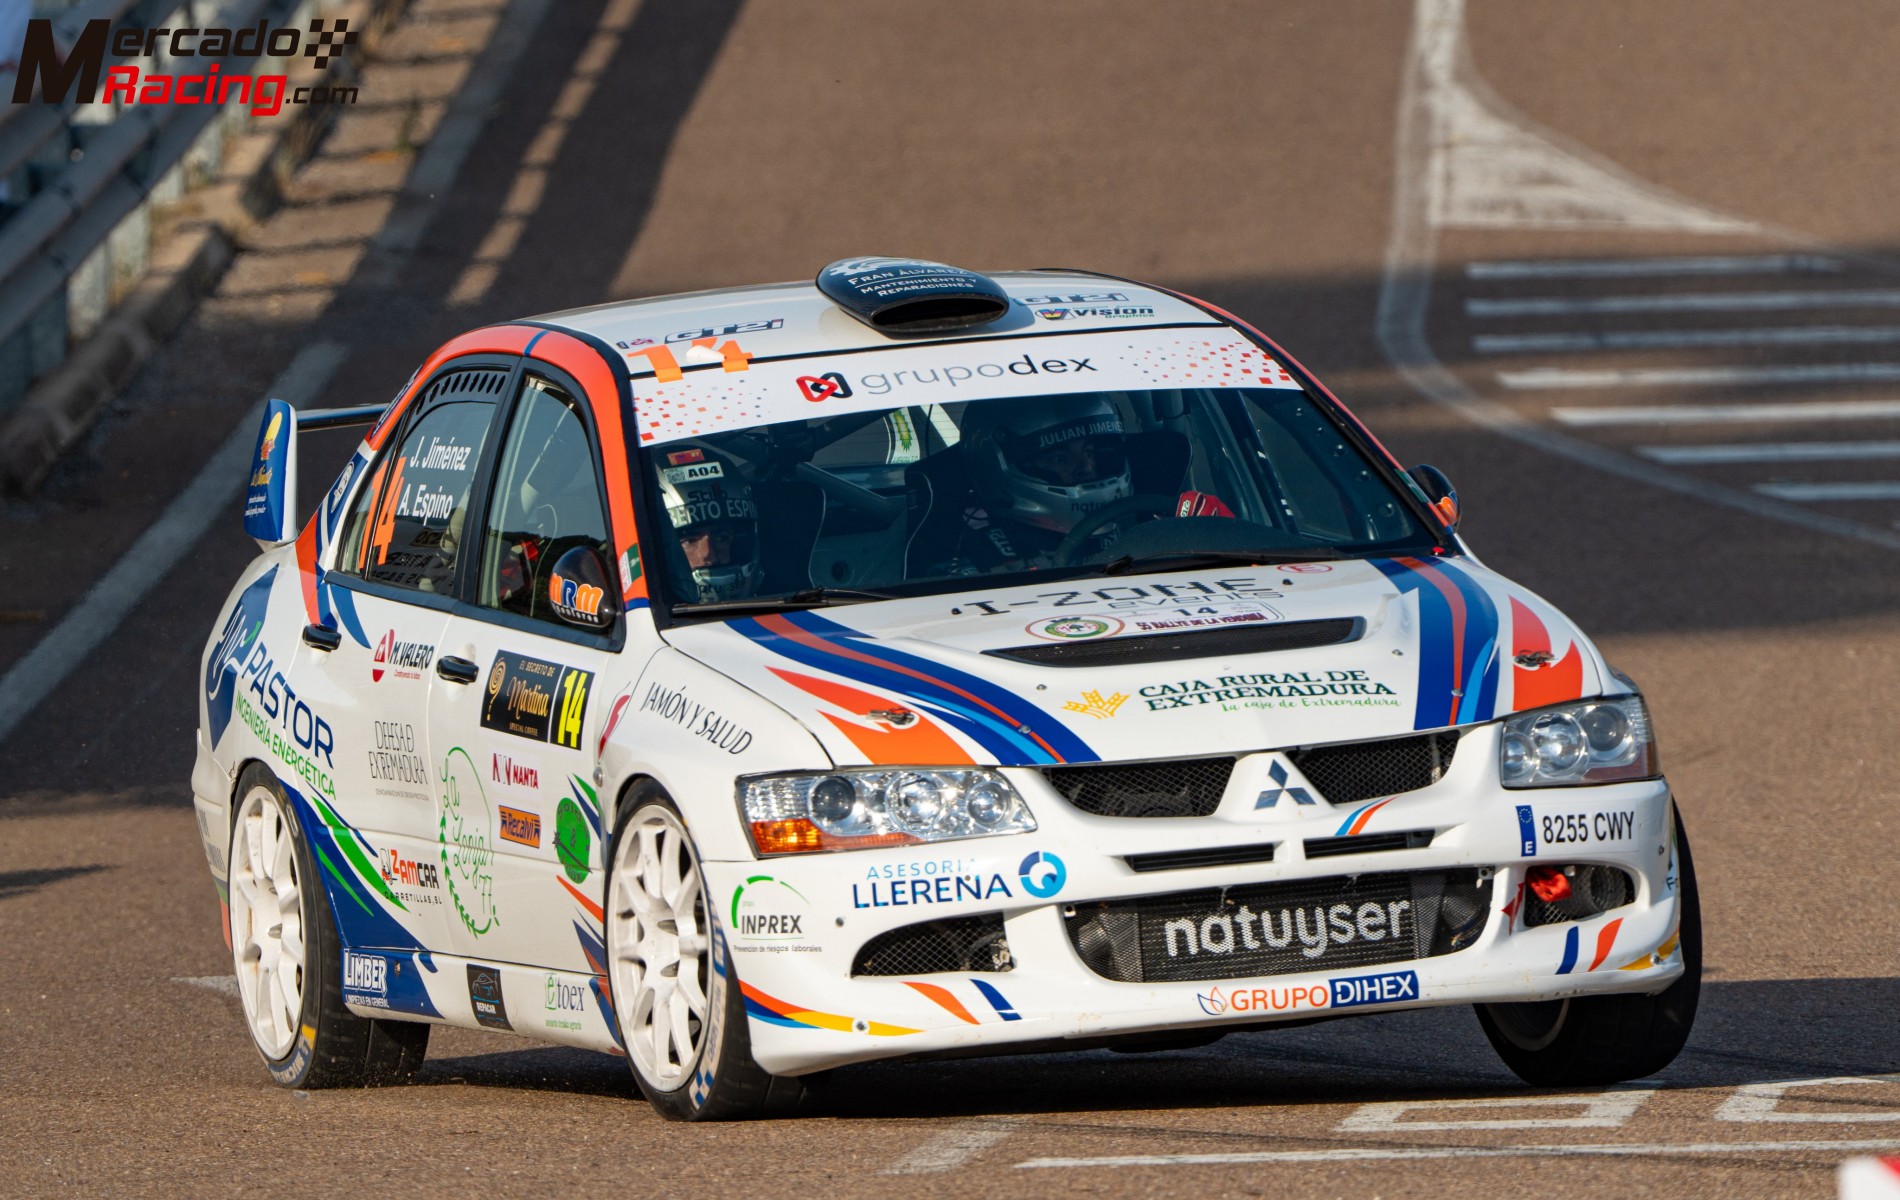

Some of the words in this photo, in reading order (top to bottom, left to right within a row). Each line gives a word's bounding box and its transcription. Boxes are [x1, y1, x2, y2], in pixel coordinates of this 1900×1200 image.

[848, 272, 894, 286] FRAN
[861, 277, 966, 294] MANTENIMIENTO
[878, 283, 974, 297] REPARACIONES
[861, 354, 1099, 395] grupodex
[1039, 425, 1087, 448] JULIAN
[410, 436, 420, 469] J.
[422, 436, 471, 471] Jiménez
[688, 465, 721, 479] A04
[359, 457, 407, 570] 14
[397, 484, 410, 517] A.
[412, 485, 453, 526] Espino
[1108, 591, 1284, 609] events
[1172, 606, 1218, 617] 14
[506, 676, 550, 720] Martina
[1139, 679, 1215, 698] CAJA
[1216, 671, 1323, 687] RURAL
[1324, 669, 1370, 682] DE
[1144, 682, 1397, 711] EXTREMADURA
[241, 642, 335, 769] PASTOR
[558, 669, 588, 748] 14
[640, 682, 693, 725] JAMÓN
[686, 703, 705, 730] Y
[1244, 699, 1274, 710] caja
[1278, 698, 1295, 709] de
[1301, 696, 1402, 708] Extremadura
[236, 690, 271, 748] INGENIERÍA
[271, 733, 337, 801] ENERGÉTICA
[695, 710, 753, 755] SALUD
[512, 763, 539, 790] NANTA
[507, 812, 535, 842] Recalvi
[1542, 813, 1589, 844] 8255
[1594, 810, 1635, 842] CWY
[1524, 841, 1533, 854] E
[390, 849, 440, 890] ZAMCAR
[852, 873, 1013, 909] LLERENA
[741, 914, 803, 935] INPREX
[1164, 899, 1411, 959] natuyser
[766, 945, 789, 954] riesgos
[791, 944, 823, 953] laborales
[344, 949, 388, 998] LIMBER
[1230, 985, 1329, 1012] GRUPO
[1335, 974, 1415, 1005] DIHEX
